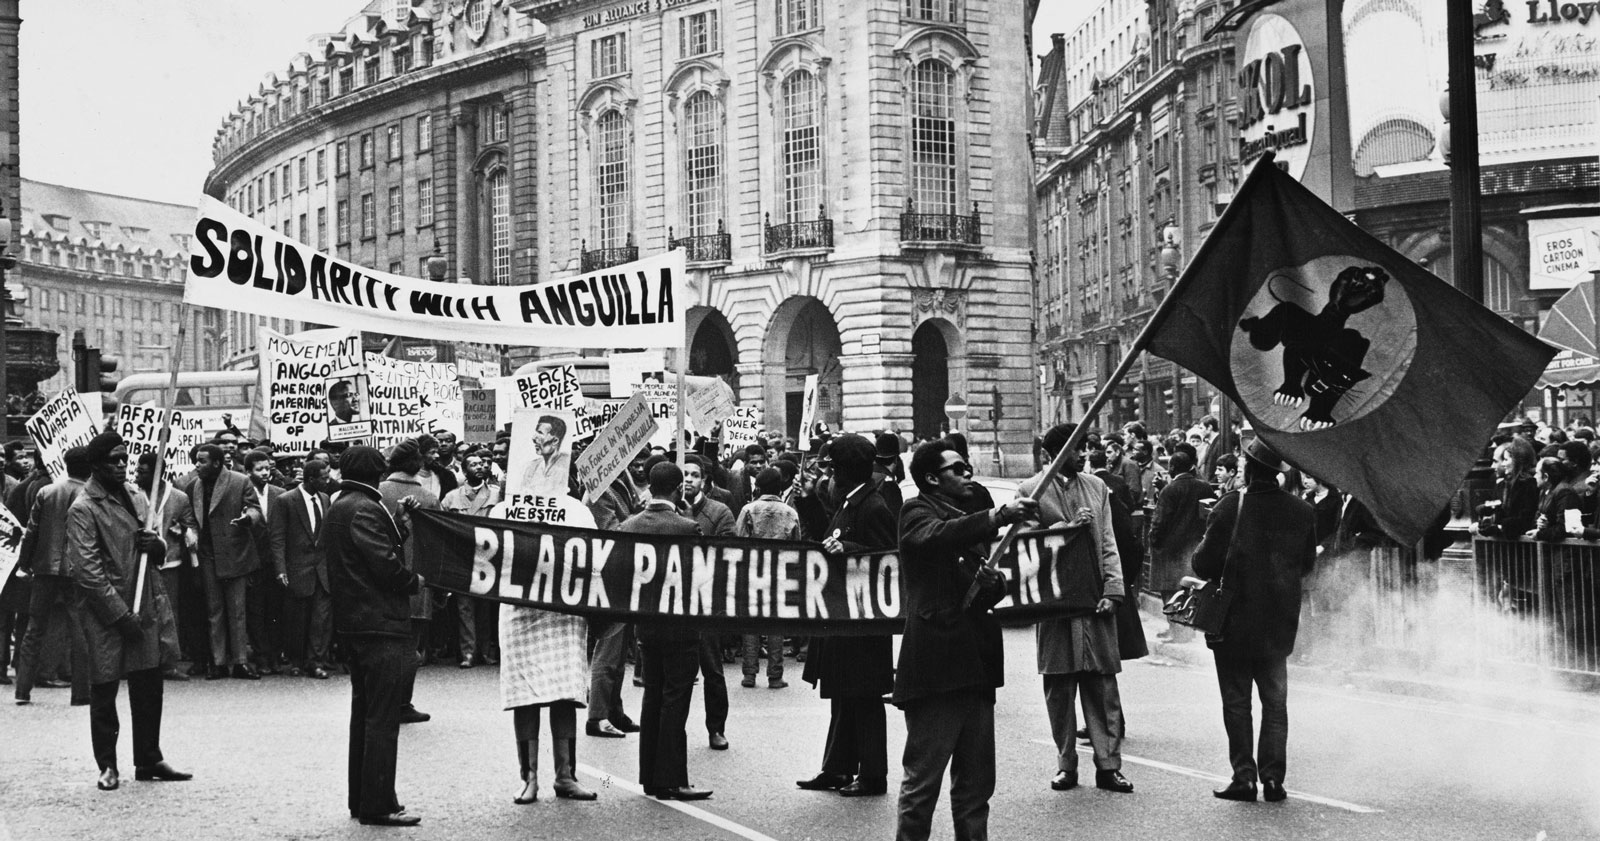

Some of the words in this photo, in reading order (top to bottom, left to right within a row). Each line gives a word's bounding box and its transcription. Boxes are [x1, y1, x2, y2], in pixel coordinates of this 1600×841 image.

[583, 13, 600, 28] SUN
[605, 1, 649, 22] ALLIANCE
[1526, 0, 1600, 25] Lloy
[1547, 239, 1573, 251] EROS
[1543, 248, 1584, 264] CARTOON
[190, 217, 400, 311] SOLIDARITY
[411, 290, 502, 321] WITH
[520, 267, 675, 327] ANGUILLA
[1547, 263, 1580, 274] CINEMA
[268, 336, 358, 359] MOVEMENT
[517, 365, 575, 393] BLACK
[368, 386, 418, 400] NGUILLA
[472, 390, 486, 401] NO
[521, 378, 579, 408] PEOPLES
[42, 387, 76, 421] BRITISH
[270, 397, 328, 409] IMPERIALIS
[398, 403, 419, 417] BE
[544, 394, 573, 410] THE
[50, 401, 81, 438] MAFIA
[726, 419, 757, 430] OWER
[28, 417, 53, 449] NO
[287, 426, 304, 436] OF
[57, 434, 68, 449] IN
[579, 465, 591, 479] NO
[588, 445, 609, 469] FORCE
[607, 435, 617, 448] IN
[615, 402, 645, 440] RHODESIA
[586, 478, 600, 493] NO
[597, 454, 620, 482] FORCE
[618, 447, 628, 459] IN
[625, 414, 655, 453] ANGUILLA
[512, 495, 557, 507] FREE
[506, 508, 566, 522] WEBSTER
[470, 527, 615, 609] BLACK
[630, 542, 828, 619] PANTHER
